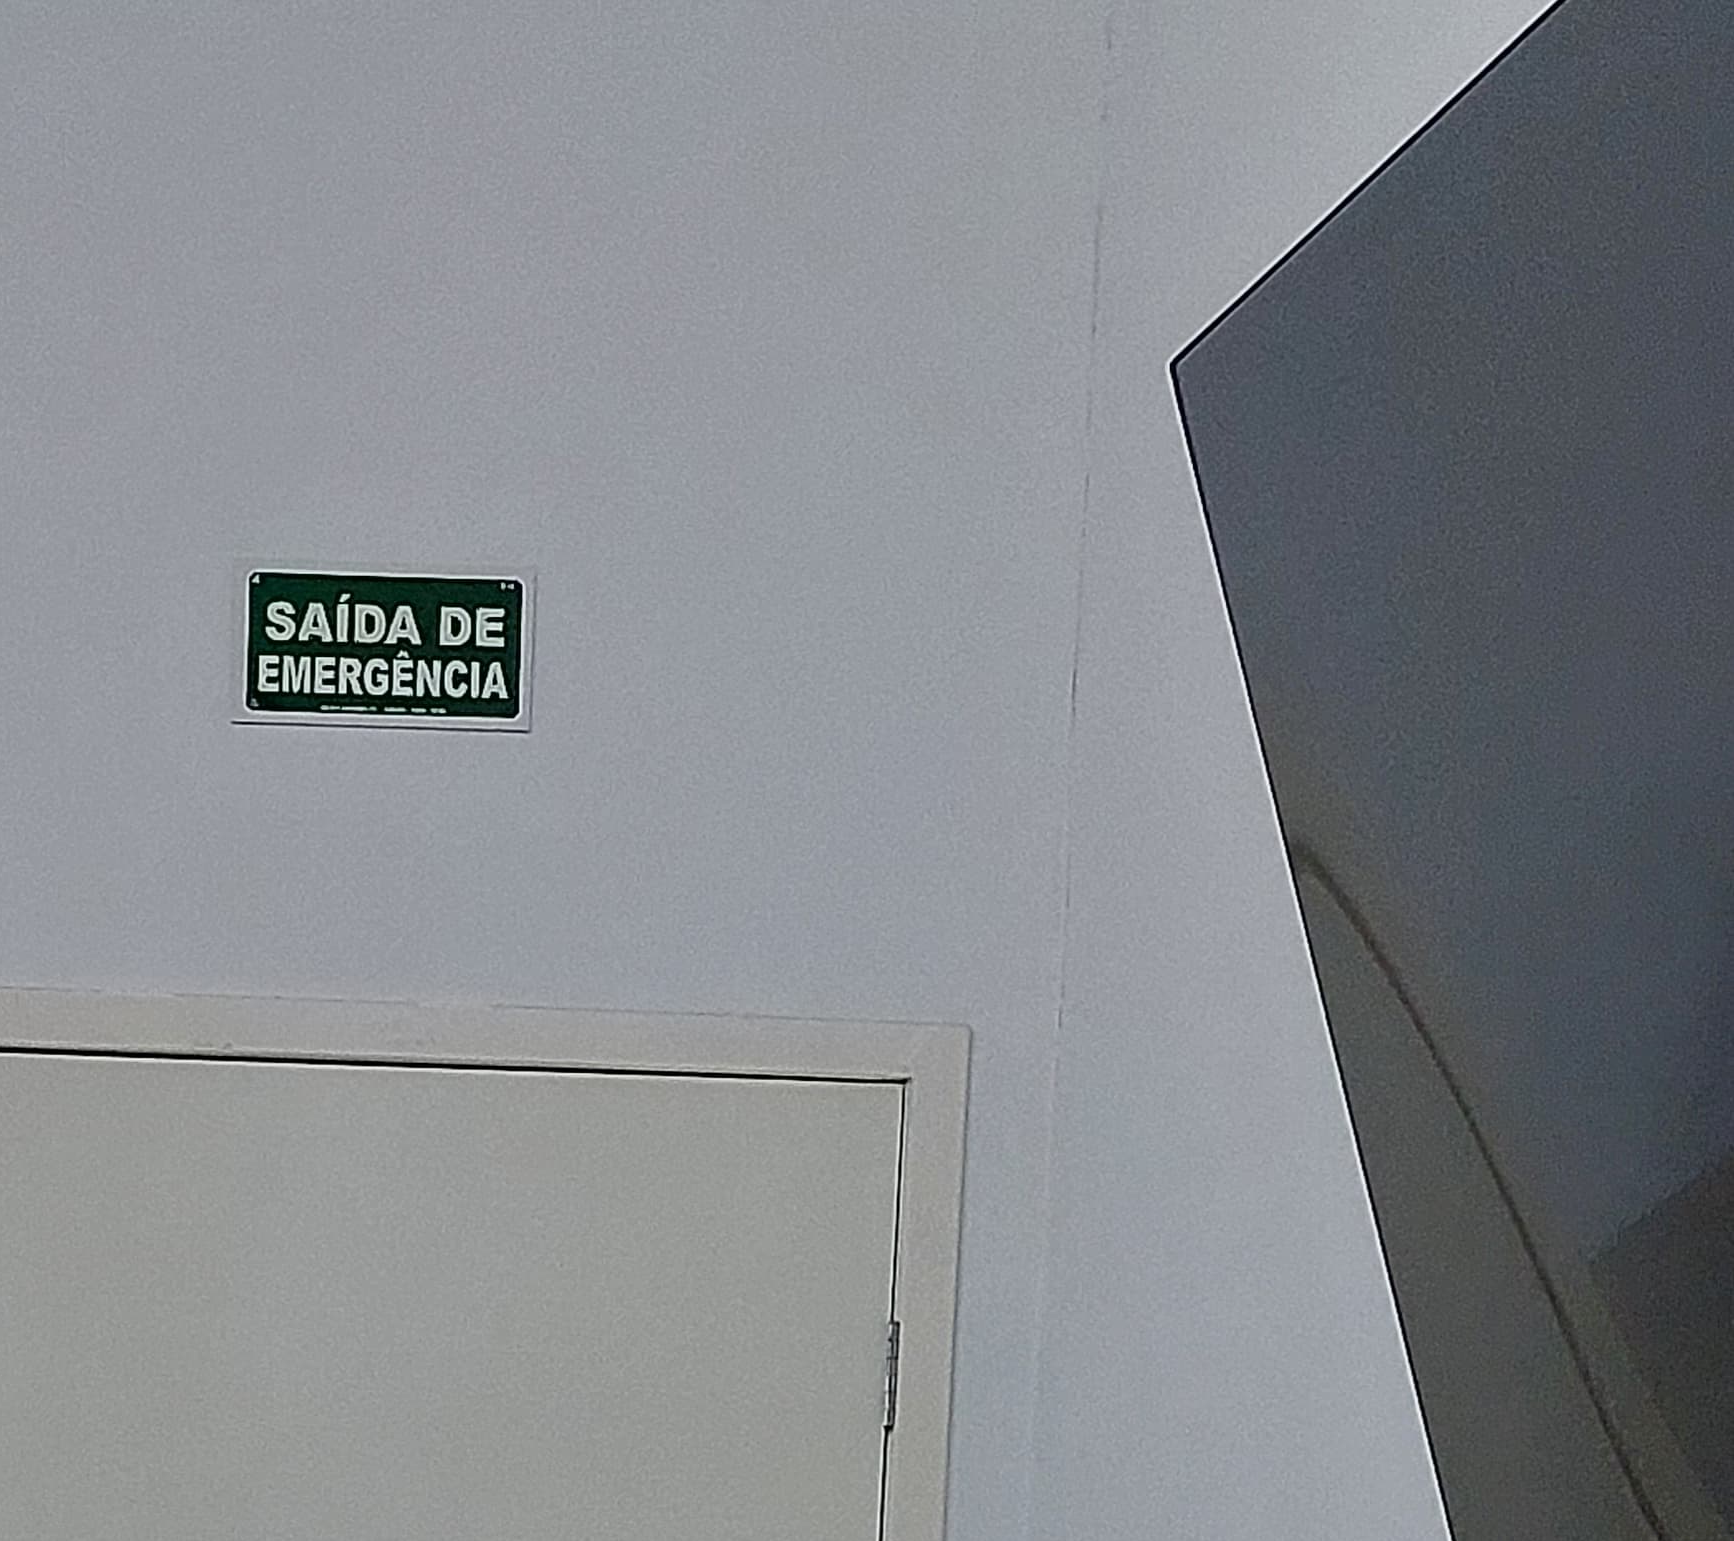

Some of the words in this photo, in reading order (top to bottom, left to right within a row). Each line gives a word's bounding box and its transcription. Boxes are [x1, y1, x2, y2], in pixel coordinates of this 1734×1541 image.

[265, 594, 422, 645] SAÍDA
[439, 606, 505, 647] DE
[257, 650, 510, 699] EMERGÊNCIA
